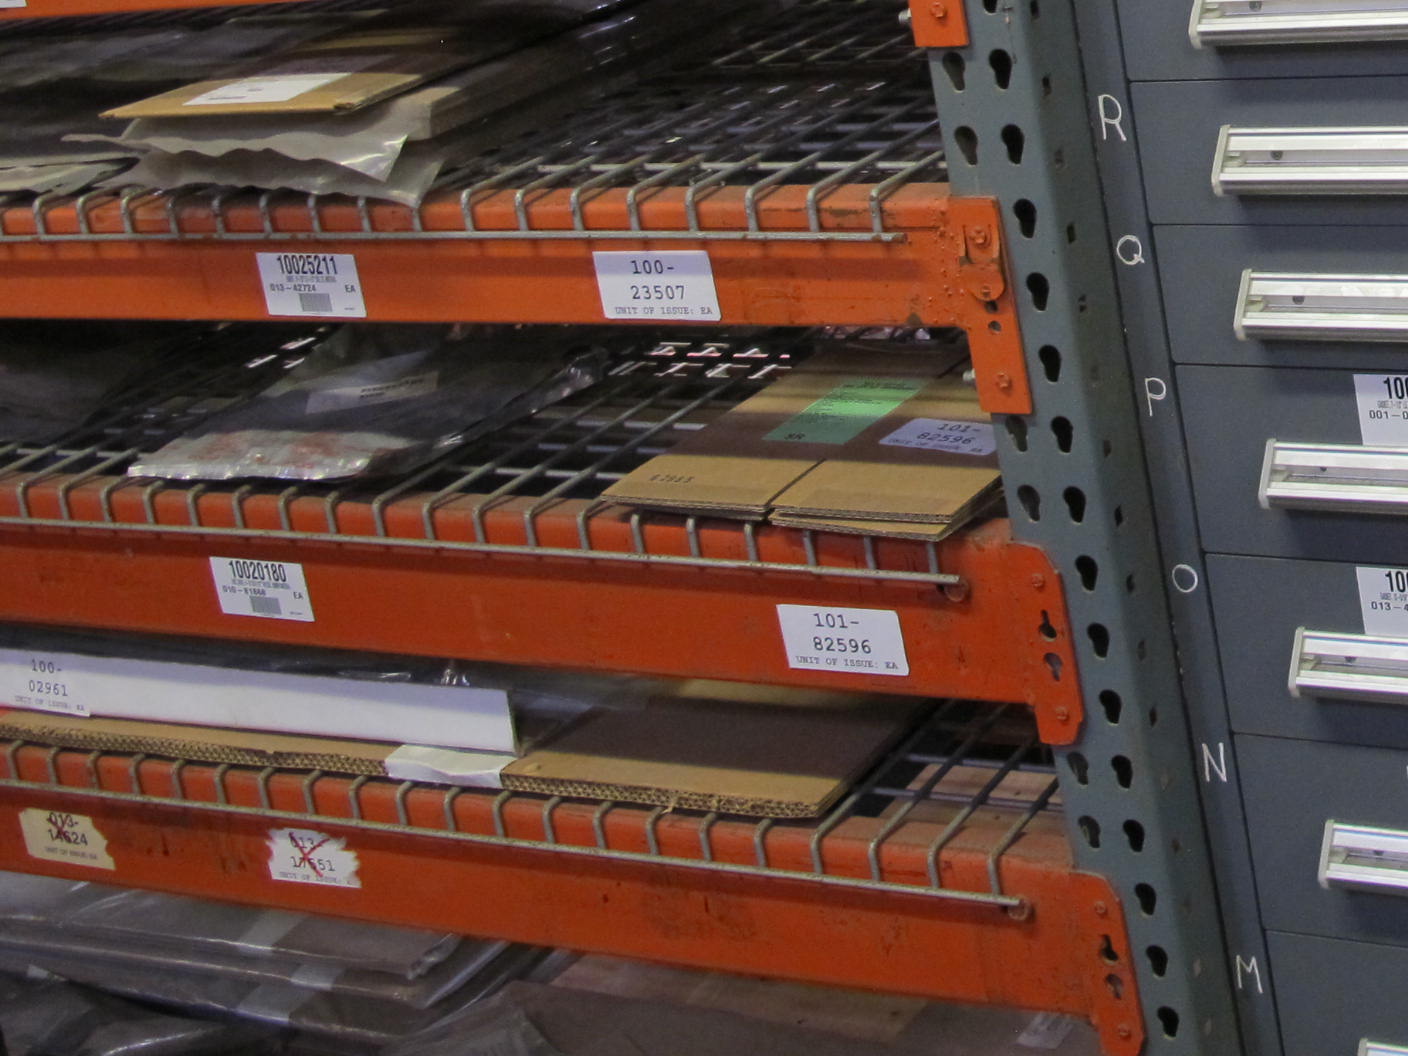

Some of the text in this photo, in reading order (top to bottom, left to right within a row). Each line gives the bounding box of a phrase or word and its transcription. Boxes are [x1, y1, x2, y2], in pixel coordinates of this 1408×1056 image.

[1098, 94, 1127, 142] R
[1117, 234, 1145, 266] Q
[277, 254, 338, 275] 10025211
[631, 259, 675, 275] 100-
[345, 285, 355, 293] EA
[630, 285, 685, 300] 23507
[614, 306, 713, 315] UNIT OF ISSUE: EA
[1144, 377, 1167, 417] P
[229, 560, 287, 583] 10020180
[293, 591, 304, 600] EA
[813, 612, 860, 629] 101-
[813, 636, 872, 654] 82596
[31, 658, 62, 673] 100-
[796, 655, 899, 670] UNIT OF ISSUE: EA
[28, 679, 68, 697] 02961
[1201, 742, 1228, 783] N
[1235, 956, 1263, 994] M
